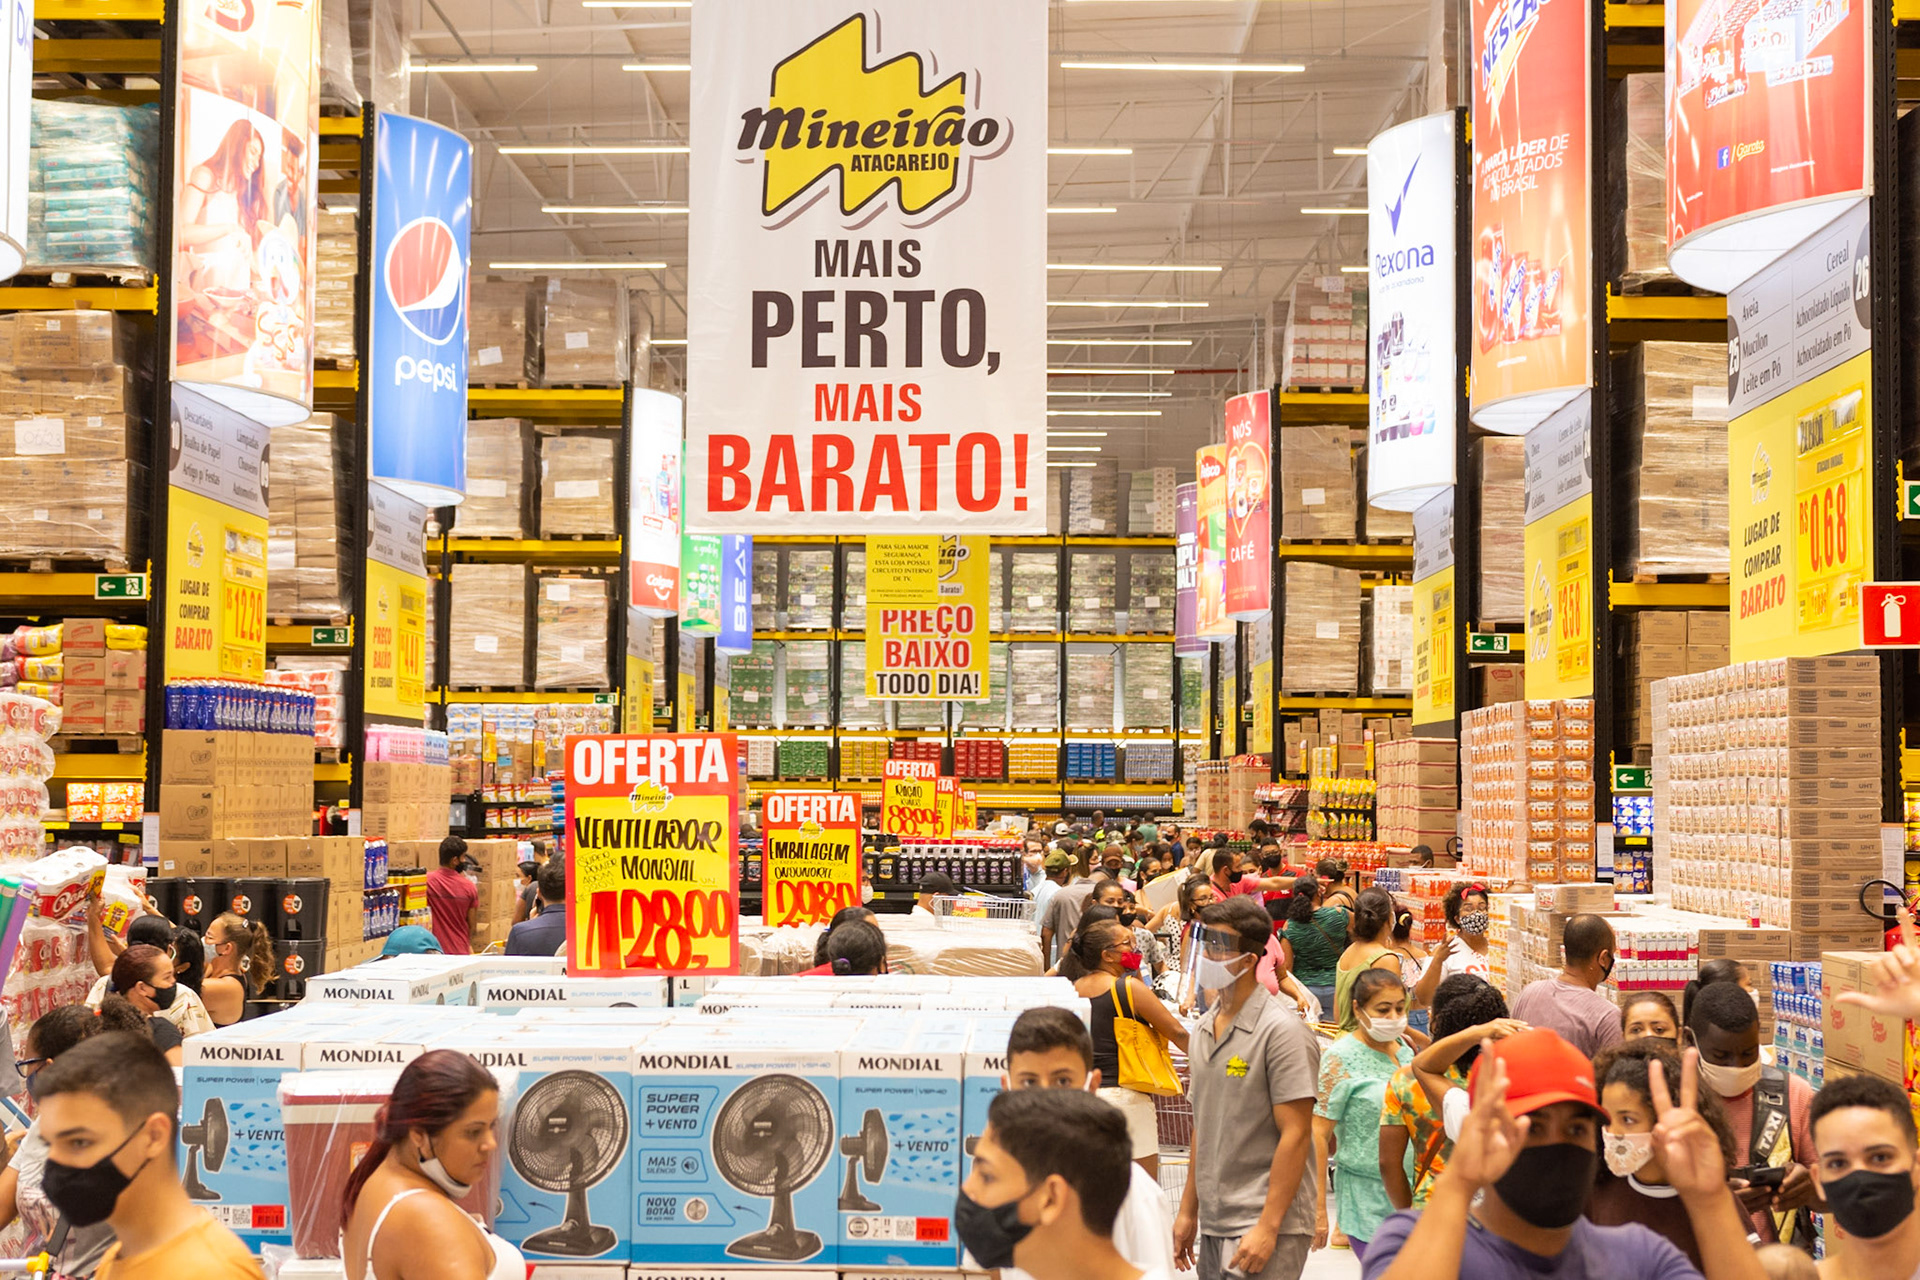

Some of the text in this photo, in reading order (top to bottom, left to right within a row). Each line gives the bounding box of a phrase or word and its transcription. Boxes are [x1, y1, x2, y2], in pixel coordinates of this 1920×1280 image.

[1483, 0, 1545, 89] NESCA
[737, 105, 1000, 150] Mineirão
[1550, 133, 1570, 152] DE
[851, 153, 950, 172] ATACAREJO
[1501, 174, 1538, 197] BRASIL
[814, 239, 922, 278] MAIS
[1376, 244, 1434, 278] Rexona
[1826, 240, 1850, 272] Cereal
[1856, 255, 1869, 300] 26
[1742, 297, 1759, 322] Aveia
[1796, 292, 1830, 330] Achocolatado
[751, 288, 1000, 376] PERTO,
[1796, 320, 1852, 368] Achocolatado em Pó
[1728, 336, 1739, 376] 25
[395, 354, 459, 393] pepsi
[1742, 356, 1782, 394] Leite em Pó
[814, 382, 922, 422] MAIS
[1232, 420, 1252, 442] NÓS
[706, 432, 1029, 512] BARATO!
[1744, 511, 1780, 548] LUGAR DE
[1810, 482, 1847, 573] 0,68
[1230, 540, 1255, 563] CAFÉ
[1744, 544, 1782, 578] COMPRAR
[180, 579, 210, 597] LUGAR DE
[734, 535, 747, 632] BEAT
[1740, 573, 1786, 620] BARATO
[180, 604, 210, 620] COMPRAR
[882, 606, 973, 638] PREÇO
[174, 626, 213, 650] BARATO
[373, 626, 392, 650] PREÇO
[373, 650, 392, 670] BAIXO
[885, 640, 970, 668] BAIXO
[876, 674, 979, 694] TODO DIA!
[573, 738, 729, 785] OFERTA
[885, 760, 936, 777] OFERTA
[767, 795, 856, 823] OFERTA
[574, 816, 723, 854] VENTILADOR
[769, 838, 850, 864] EMBALAGEM
[621, 854, 698, 882] MONDIAL
[323, 988, 395, 1000] MONDIAL
[487, 988, 567, 1002] MONDIAL
[200, 1046, 284, 1060] MONDIAL
[320, 1050, 405, 1062] MONDIAL
[470, 1053, 527, 1066] NDIAL
[639, 1055, 732, 1069] MONDIAL
[858, 1057, 943, 1071] MONDIAL
[646, 1094, 700, 1103] SUPER
[646, 1105, 700, 1114] POWER
[235, 1129, 244, 1139] +
[645, 1118, 697, 1129] + VENTO
[1759, 1110, 1783, 1150] TAXI
[894, 1140, 949, 1152] + VENTO
[648, 1156, 677, 1166] MAIS
[646, 1198, 676, 1207] NOVO
[646, 1206, 675, 1215] BOTÃO
